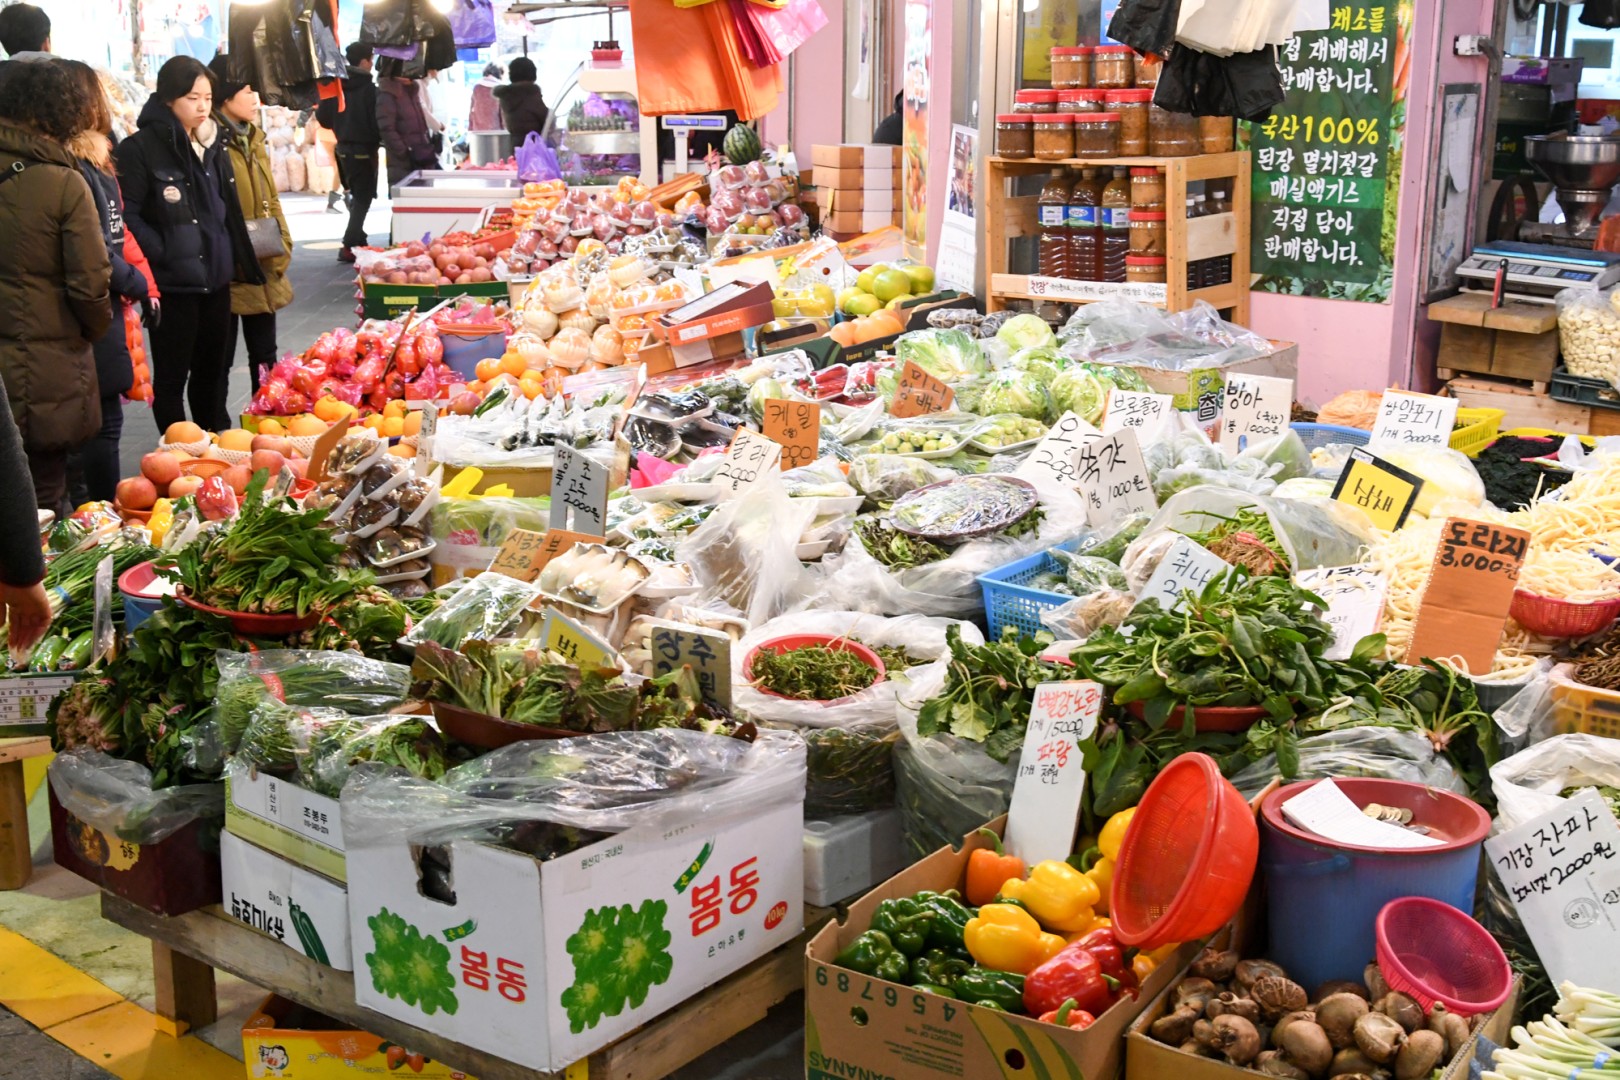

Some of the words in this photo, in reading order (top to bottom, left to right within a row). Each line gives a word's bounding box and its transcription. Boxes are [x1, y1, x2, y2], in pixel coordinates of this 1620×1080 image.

[1331, 6, 1386, 33] 채소를
[1283, 36, 1302, 62] 접
[1308, 36, 1389, 64] 재배해서
[1260, 114, 1380, 145] 국산100%
[1257, 147, 1296, 173] 된장
[1302, 149, 1379, 178] 멸치젓갈
[1269, 175, 1361, 204] 매실액기스
[1272, 206, 1308, 232] 직접
[1315, 209, 1355, 236] 담아
[1264, 235, 1364, 266] 판매합니다.
[1109, 393, 1164, 421] 브로콜리
[1226, 380, 1264, 410] 방아
[769, 402, 813, 430] 케일
[1353, 477, 1394, 513] 삼채
[1445, 521, 1527, 563] 도라지
[1440, 545, 1521, 582] 3,000원
[1037, 739, 1073, 769] 파랑
[1497, 842, 1534, 870] 기장
[1550, 841, 1617, 886] 2000원
[688, 855, 761, 938] 봄동
[459, 943, 528, 1004] 봄동
[836, 971, 850, 992] 8
[860, 981, 874, 1001] 7
[912, 994, 926, 1015] 5
[942, 1002, 956, 1022] 4
